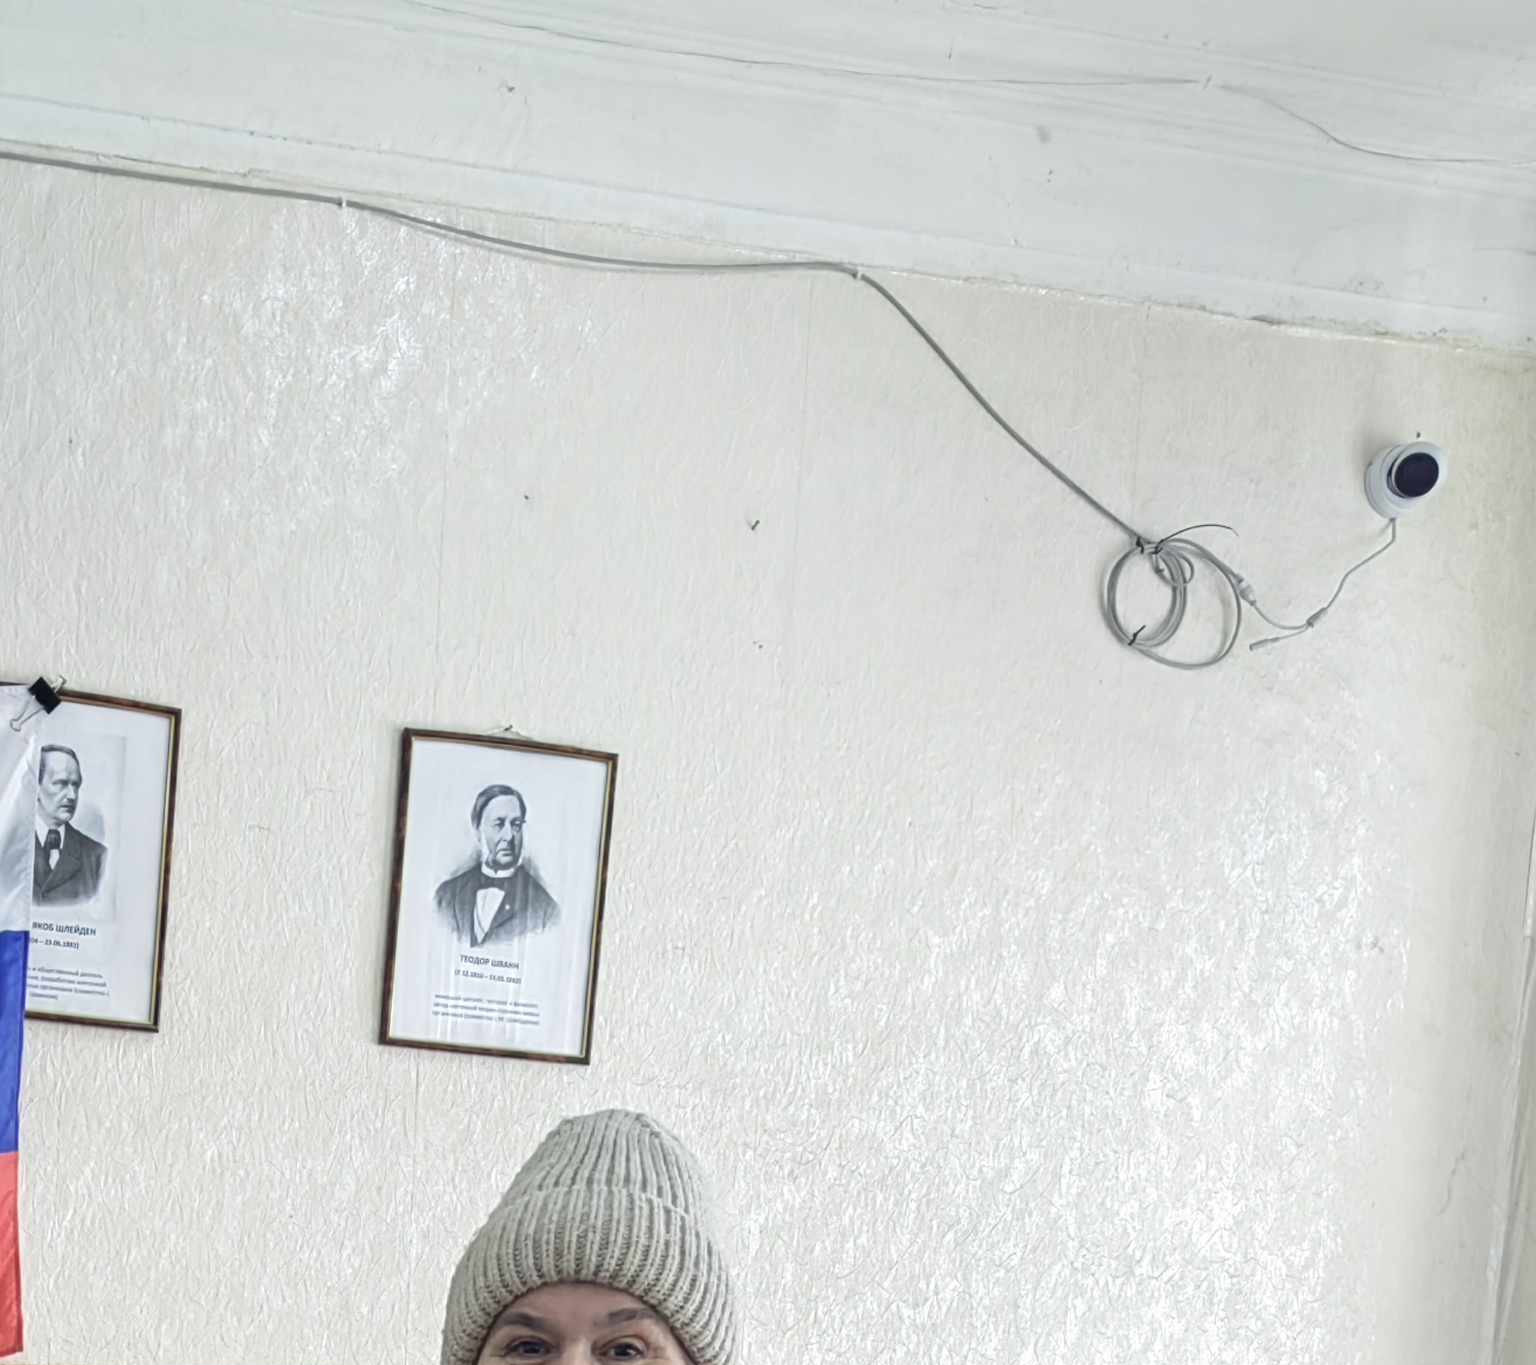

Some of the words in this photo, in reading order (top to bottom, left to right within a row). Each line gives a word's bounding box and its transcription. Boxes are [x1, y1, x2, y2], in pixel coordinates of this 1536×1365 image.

[31, 921, 54, 931] ЯКОБ
[55, 924, 97, 936] ШЛЕЙДЕН
[460, 954, 490, 966] ТЕОДОР
